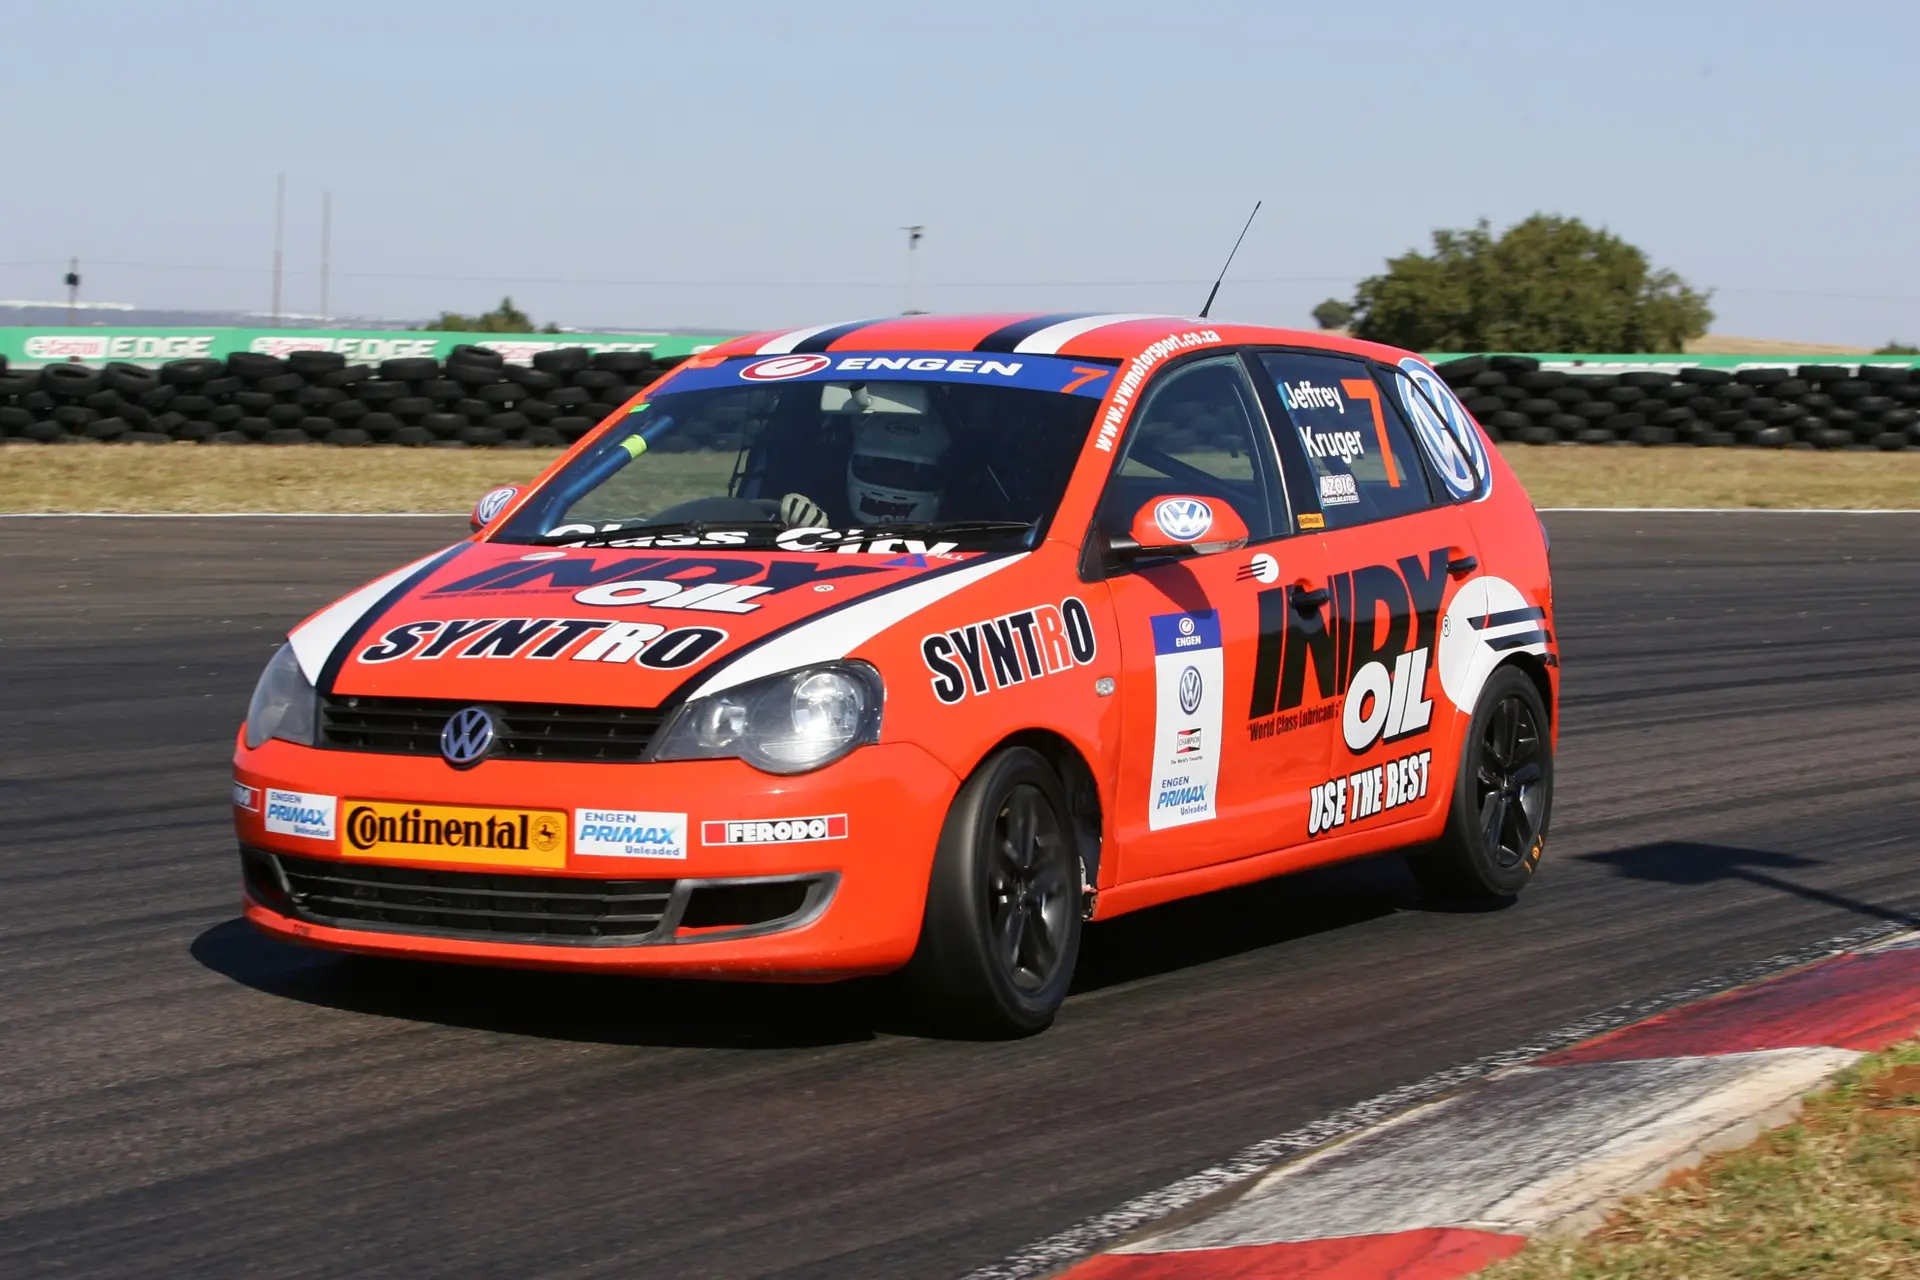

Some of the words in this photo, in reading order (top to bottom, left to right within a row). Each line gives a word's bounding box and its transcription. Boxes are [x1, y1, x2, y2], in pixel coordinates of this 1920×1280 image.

[108, 336, 215, 358] EDGE
[335, 338, 439, 360] EDGE
[836, 358, 1023, 376] ENGEN
[1060, 366, 1109, 393] 7
[1095, 330, 1222, 452] www.vwmotorsport.co.za
[1283, 380, 1345, 414] Jeffrey
[1299, 426, 1364, 464] Kruger
[1339, 378, 1400, 488] 7
[428, 557, 900, 594] INDY
[574, 580, 775, 614] OIL
[358, 618, 728, 671] SYNTRO
[1175, 635, 1202, 647] ENGEN
[1248, 546, 1450, 720] INDY
[920, 596, 1097, 705] SYNTRO
[1343, 646, 1434, 755] OIL
[1276, 714, 1298, 735] Class
[1162, 776, 1190, 788] ENGEN
[1308, 776, 1347, 838] USE
[1350, 763, 1384, 823] THE
[1385, 748, 1432, 811] BEST
[271, 791, 302, 804] ENGEN
[1157, 783, 1208, 810] PRIMAX
[1180, 803, 1207, 816] Unleaded
[267, 804, 328, 827] PRIMAX
[347, 806, 529, 850] Continental
[585, 812, 637, 824] ENGEN
[579, 824, 678, 845] PRIMAX
[728, 819, 826, 843] FERODO
[625, 845, 680, 856] Unleaded
